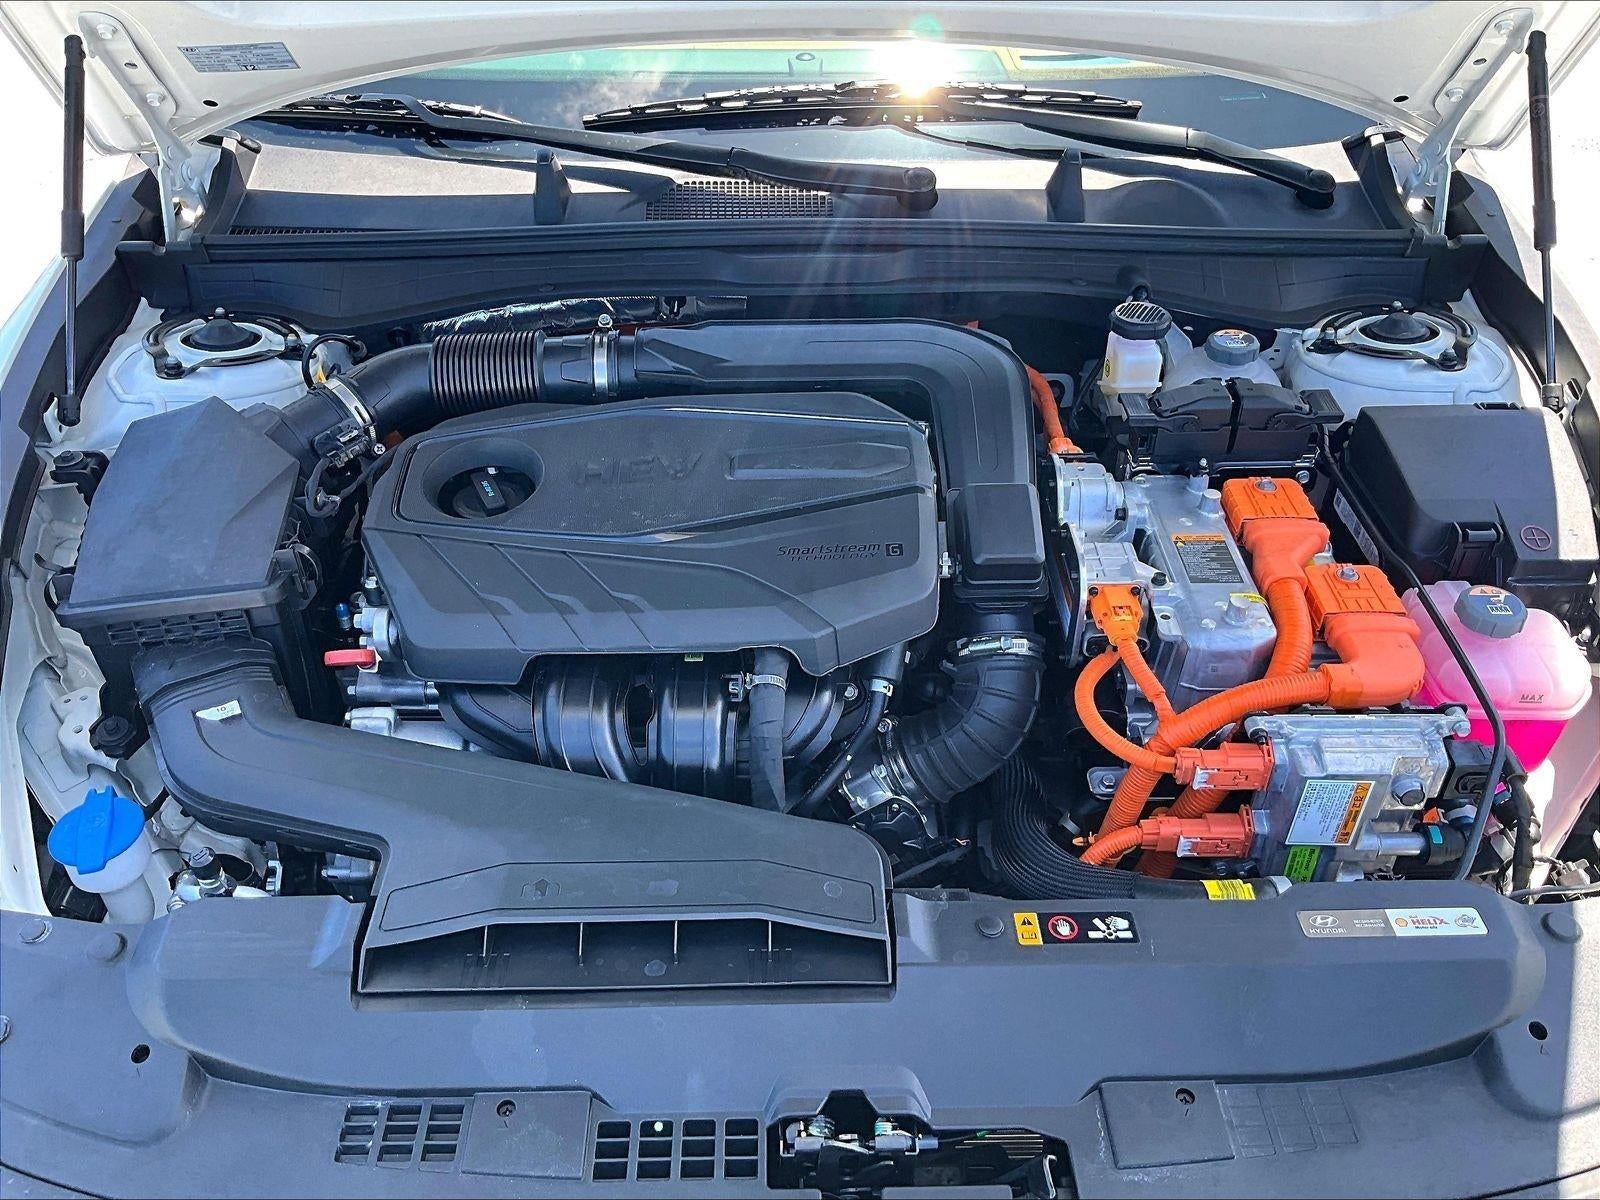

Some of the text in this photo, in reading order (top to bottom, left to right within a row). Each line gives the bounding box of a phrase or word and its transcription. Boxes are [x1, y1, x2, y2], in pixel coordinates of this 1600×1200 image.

[576, 455, 702, 485] HEV
[777, 543, 904, 557] Smartstream G
